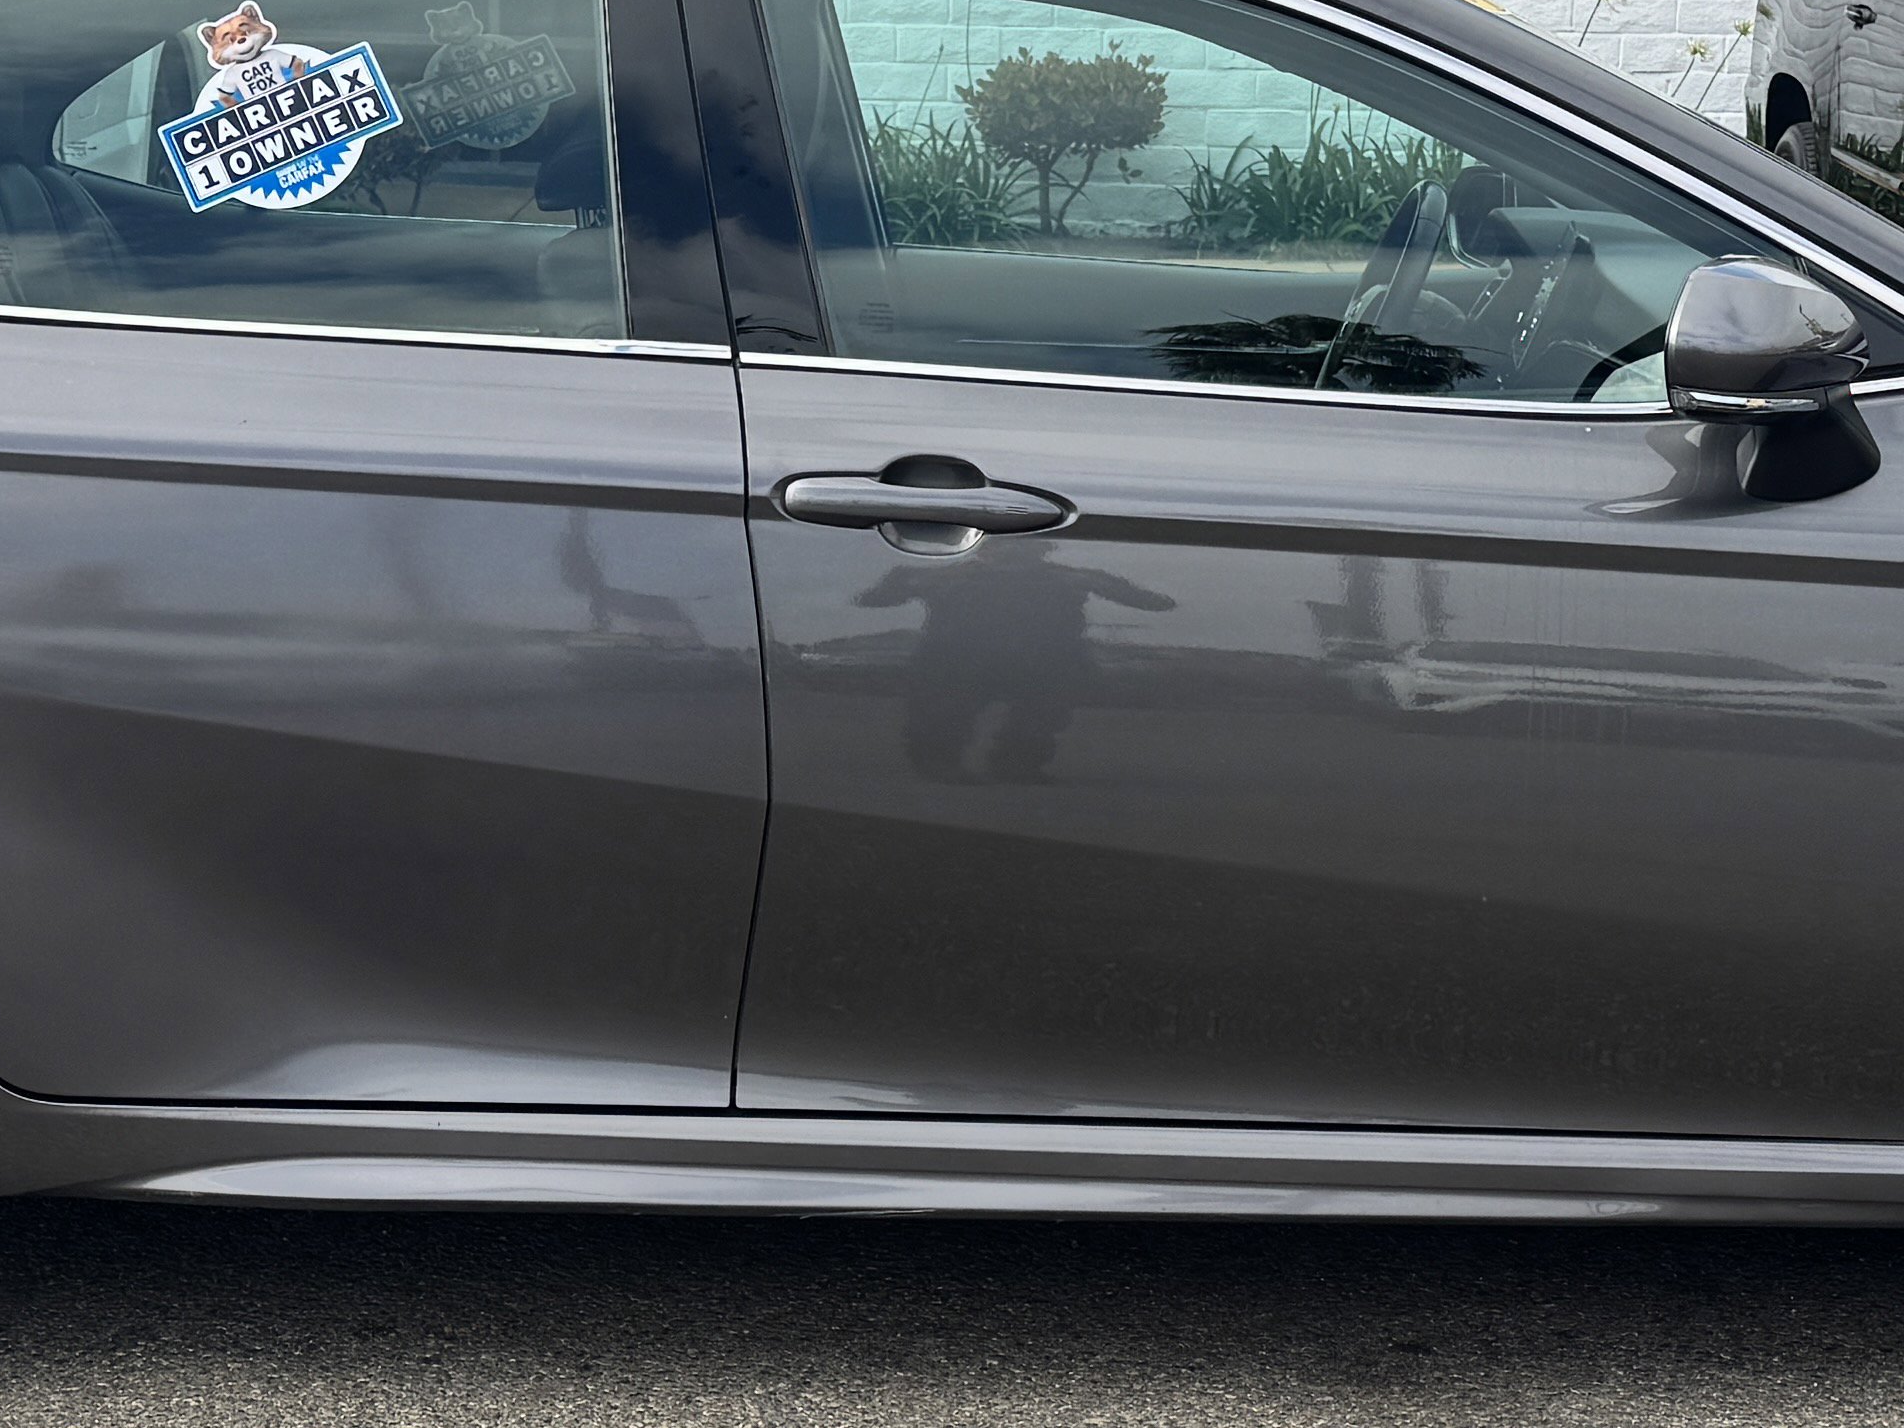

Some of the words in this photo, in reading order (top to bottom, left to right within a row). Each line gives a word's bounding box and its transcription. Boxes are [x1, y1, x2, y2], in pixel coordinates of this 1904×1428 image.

[241, 61, 273, 82] CAR
[247, 73, 279, 95] FOX
[183, 68, 367, 155] CARFAX
[198, 164, 220, 190] 1
[228, 96, 380, 171] OWNER
[278, 161, 327, 189] CARFAX
